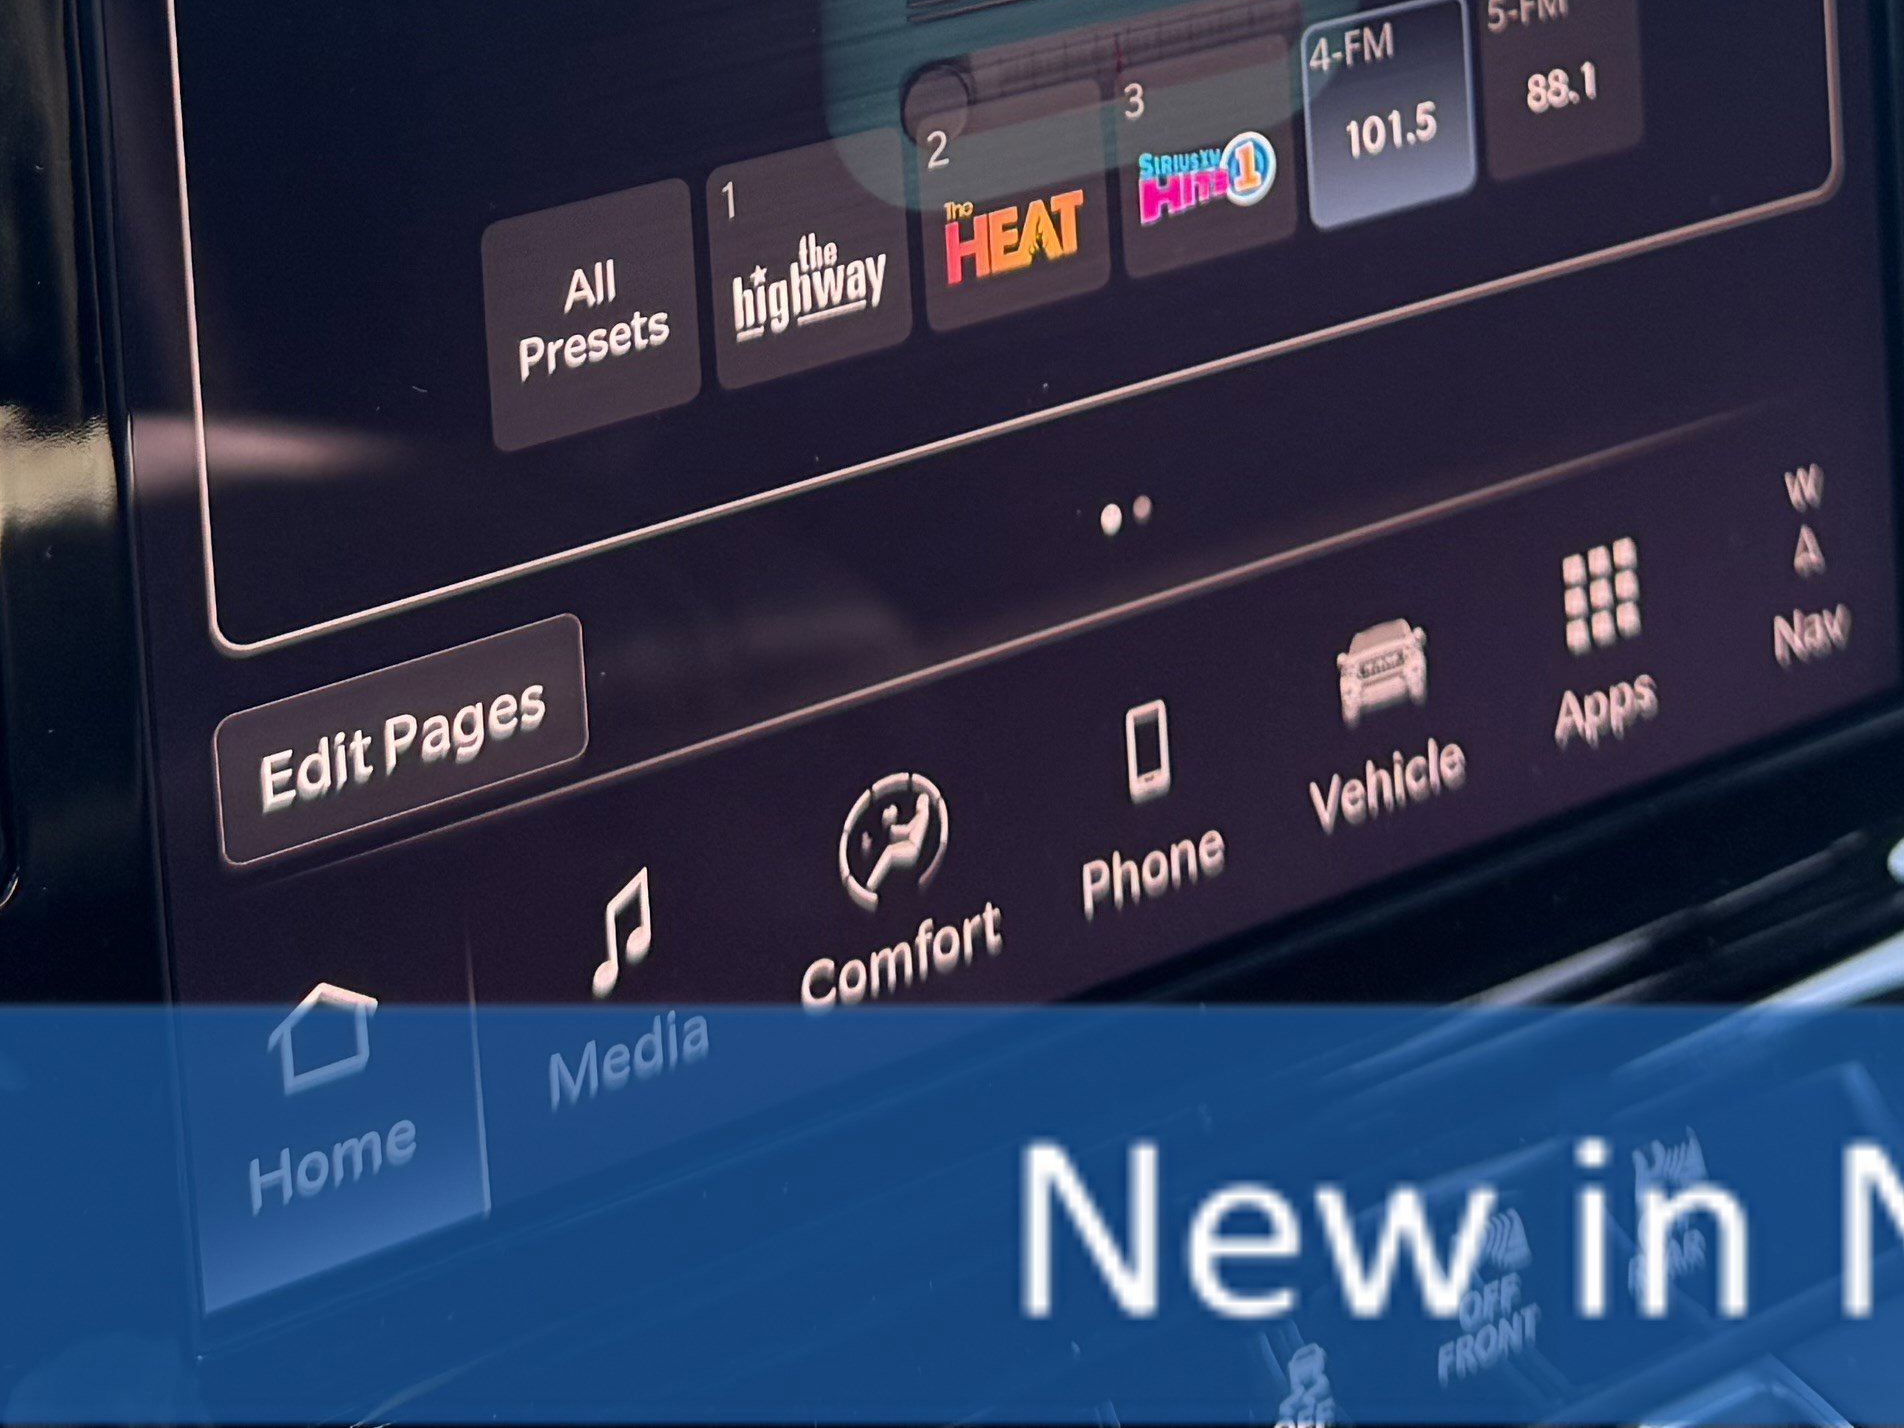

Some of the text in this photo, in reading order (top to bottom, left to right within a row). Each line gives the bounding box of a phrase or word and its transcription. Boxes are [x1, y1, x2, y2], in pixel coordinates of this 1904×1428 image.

[1309, 22, 1395, 73] 4-FM
[1124, 83, 1144, 119] 3
[1526, 61, 1597, 114] 88.1
[927, 131, 950, 170] 2
[1346, 101, 1438, 160] 101.5
[721, 180, 736, 220] 1
[798, 233, 837, 271] the
[945, 189, 1084, 285] HEAT
[563, 258, 615, 314] All
[732, 253, 887, 338] highway
[518, 309, 670, 382] Presets
[1784, 463, 1824, 512] W
[1773, 603, 1853, 667] Nav
[260, 683, 546, 815] Edit Pages
[1555, 674, 1660, 751] Apps
[1308, 737, 1467, 836] Vehicle
[1082, 829, 1226, 921] Phone
[801, 901, 1003, 1016] Comfort
[548, 1009, 710, 1111] Media
[248, 1118, 418, 1216] Home
[1438, 1302, 1542, 1390] FRONT
